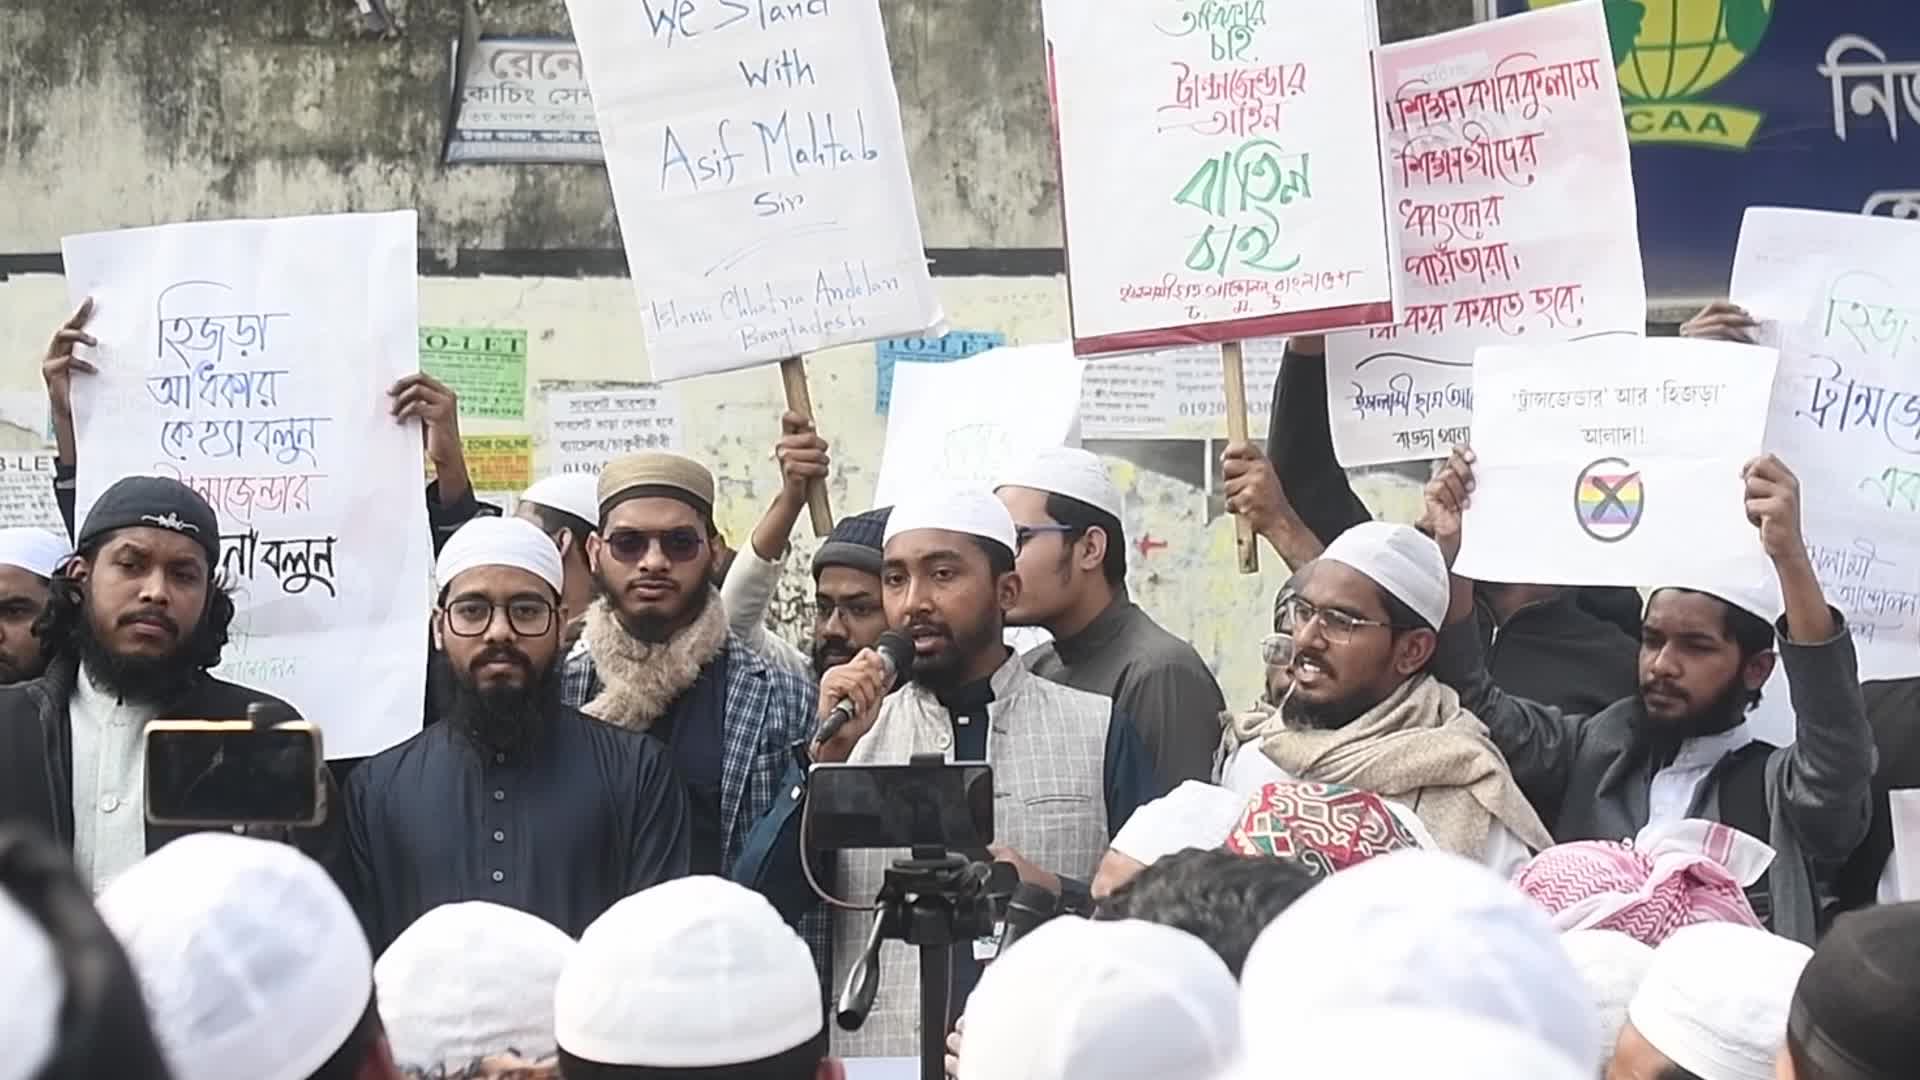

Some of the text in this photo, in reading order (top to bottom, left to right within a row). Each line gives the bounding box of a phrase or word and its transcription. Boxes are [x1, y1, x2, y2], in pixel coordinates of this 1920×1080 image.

[489, 48, 584, 81] রেনে
[1816, 34, 1920, 143] নি
[661, 109, 879, 191] Asif Mahtab
[1173, 139, 1312, 217] বাতিল
[1184, 206, 1301, 278] চাই
[157, 280, 291, 370] হিজড়া
[426, 335, 518, 352] O-LET
[247, 417, 333, 468] বলুন
[260, 535, 338, 598] বলুন
